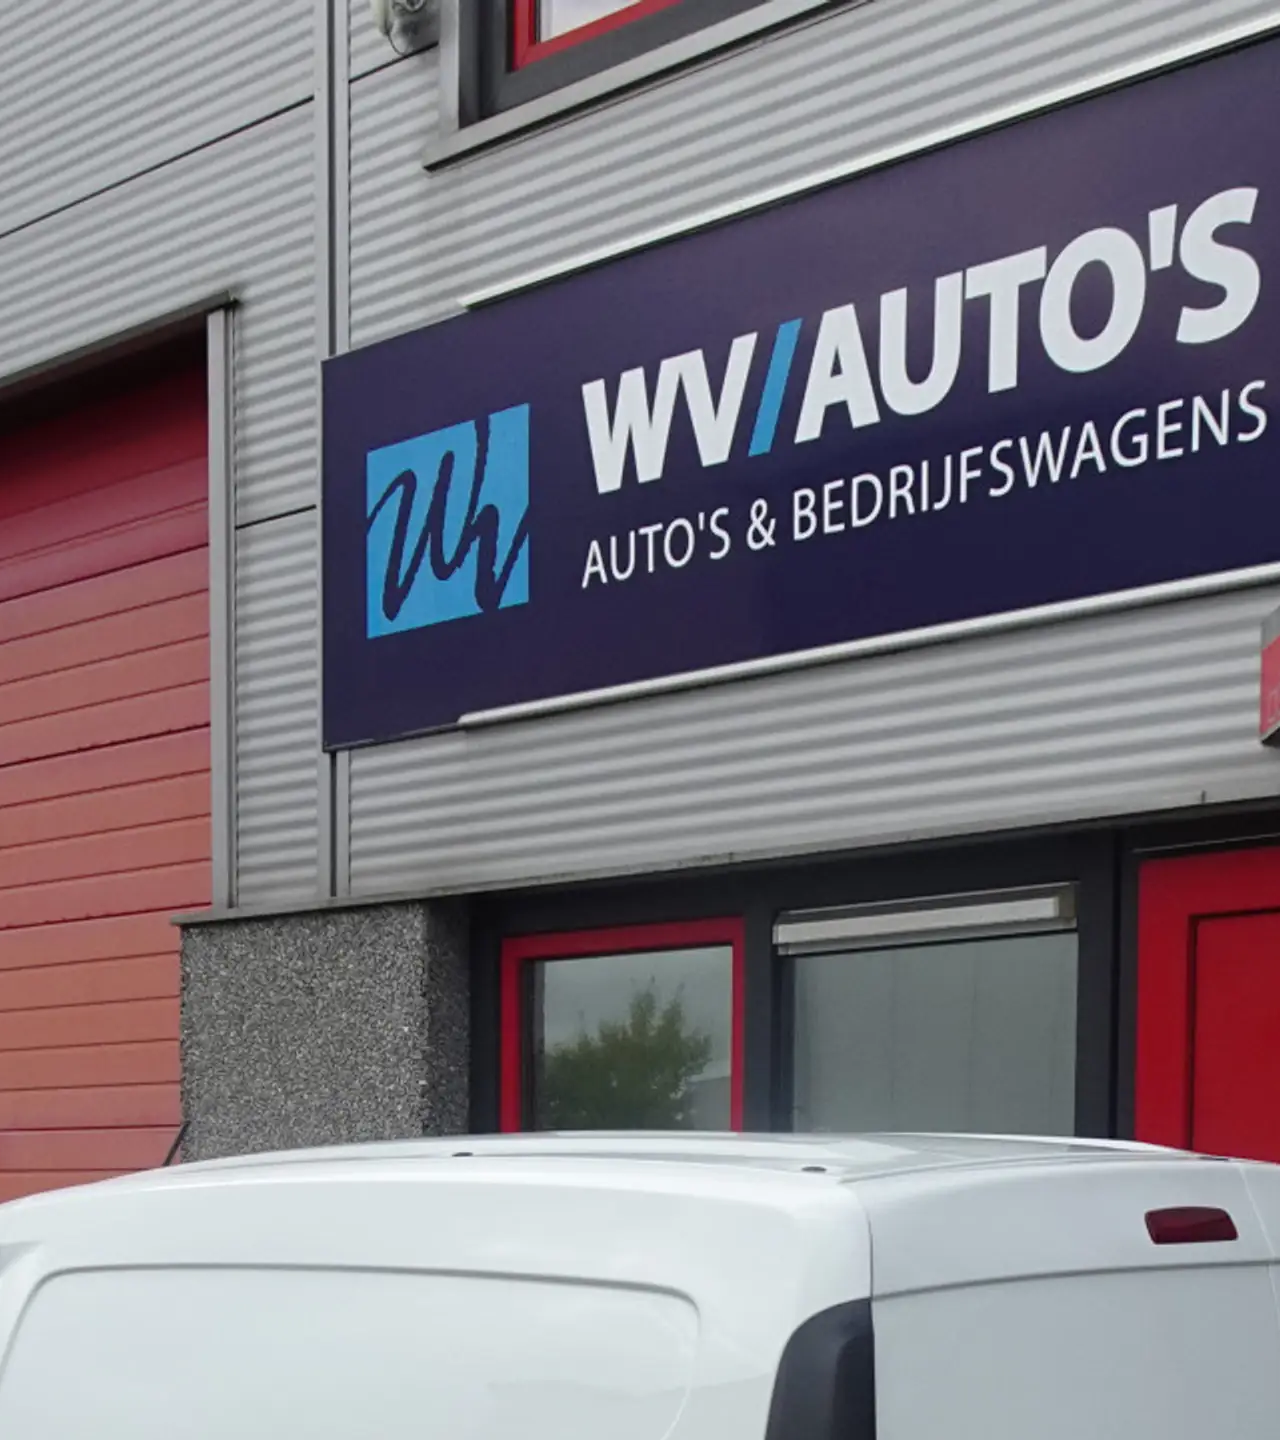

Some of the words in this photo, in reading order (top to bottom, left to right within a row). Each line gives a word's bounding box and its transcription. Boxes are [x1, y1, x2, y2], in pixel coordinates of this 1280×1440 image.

[581, 186, 1261, 495] WV/AUTO'S
[581, 506, 730, 588] AUTO'S
[745, 498, 777, 552] &
[792, 379, 1269, 541] BEDRIJFSWAGENS
